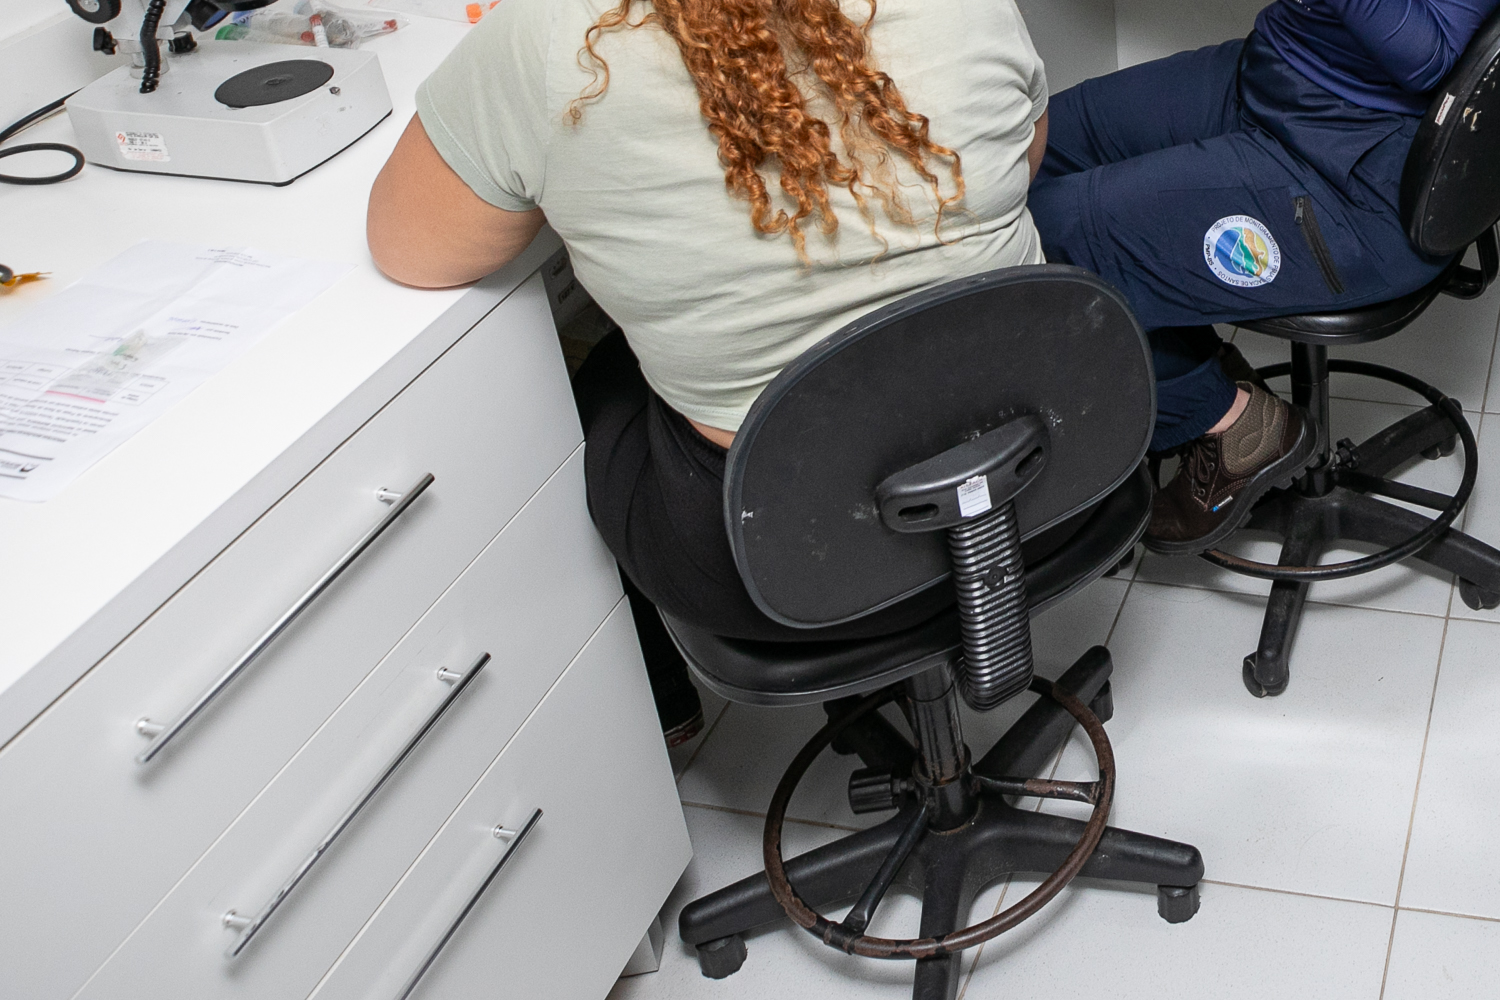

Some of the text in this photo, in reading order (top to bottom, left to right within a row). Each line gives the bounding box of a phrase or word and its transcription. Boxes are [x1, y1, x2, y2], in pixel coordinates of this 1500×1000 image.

[1212, 216, 1235, 233] PROJETO
[1244, 216, 1280, 256] MONITORAMENTO
[1216, 270, 1239, 285] SANTOS
